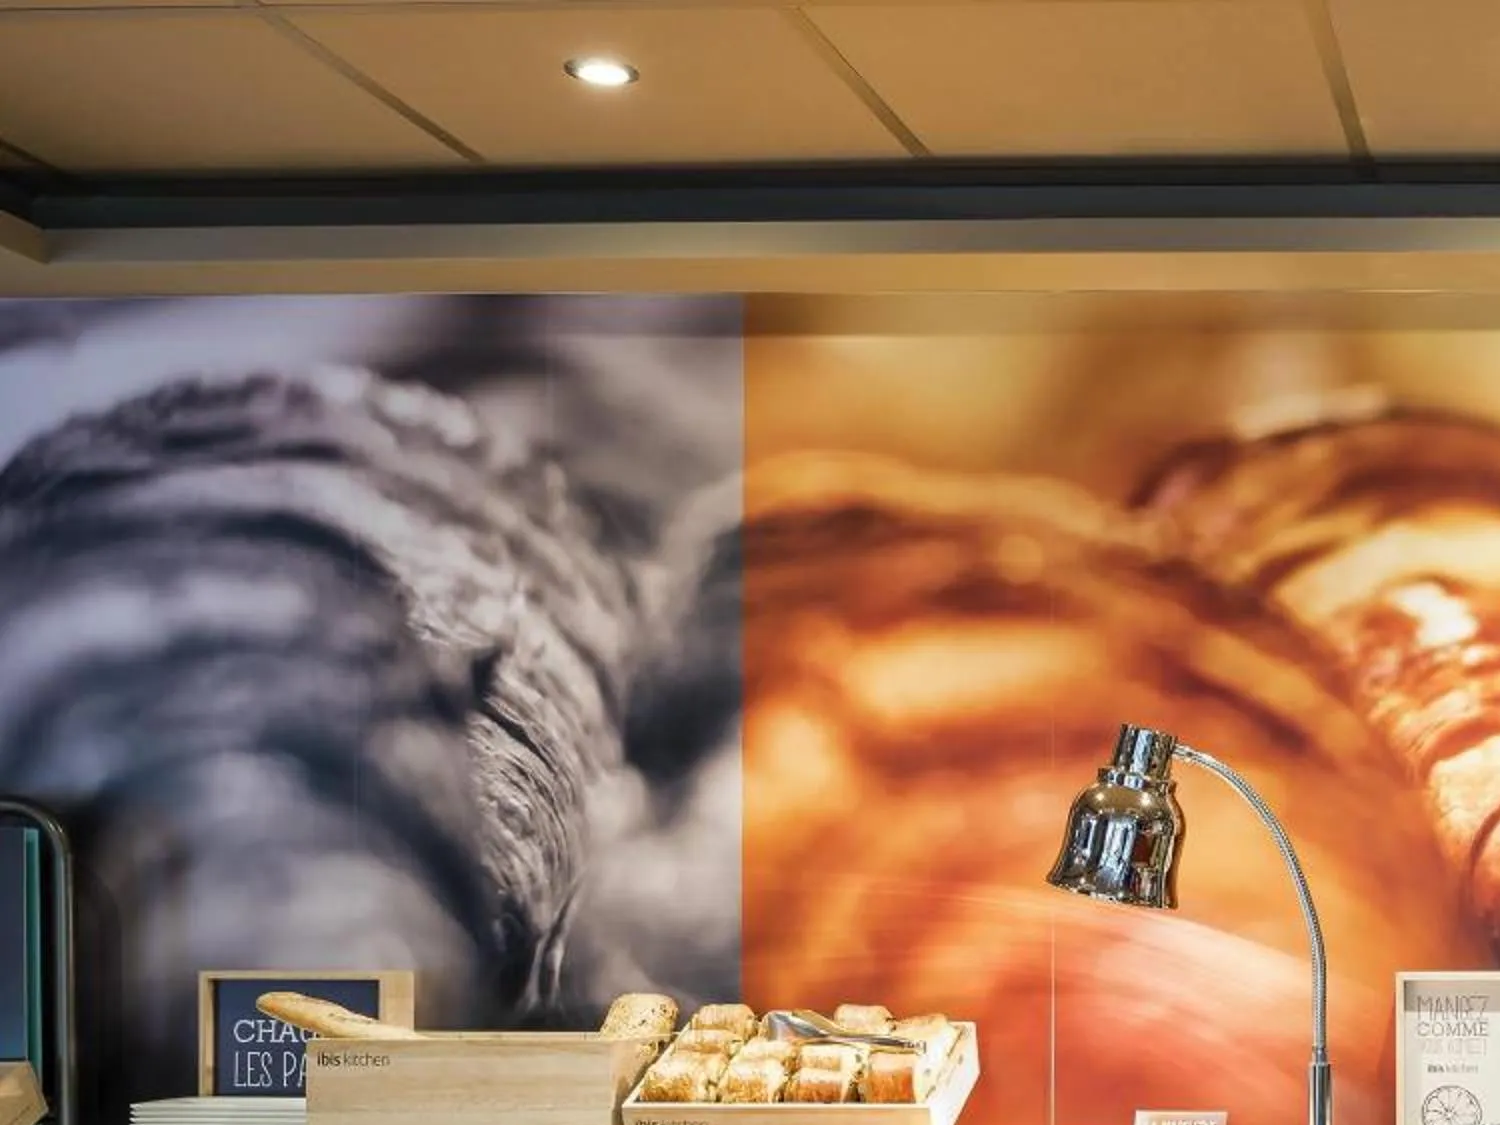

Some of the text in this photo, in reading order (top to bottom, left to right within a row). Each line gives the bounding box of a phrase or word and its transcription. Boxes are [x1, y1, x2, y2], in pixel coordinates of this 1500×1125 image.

[1417, 1021, 1490, 1037] COMME
[316, 1051, 391, 1067] ibis kitchen
[234, 1051, 273, 1087] LES
